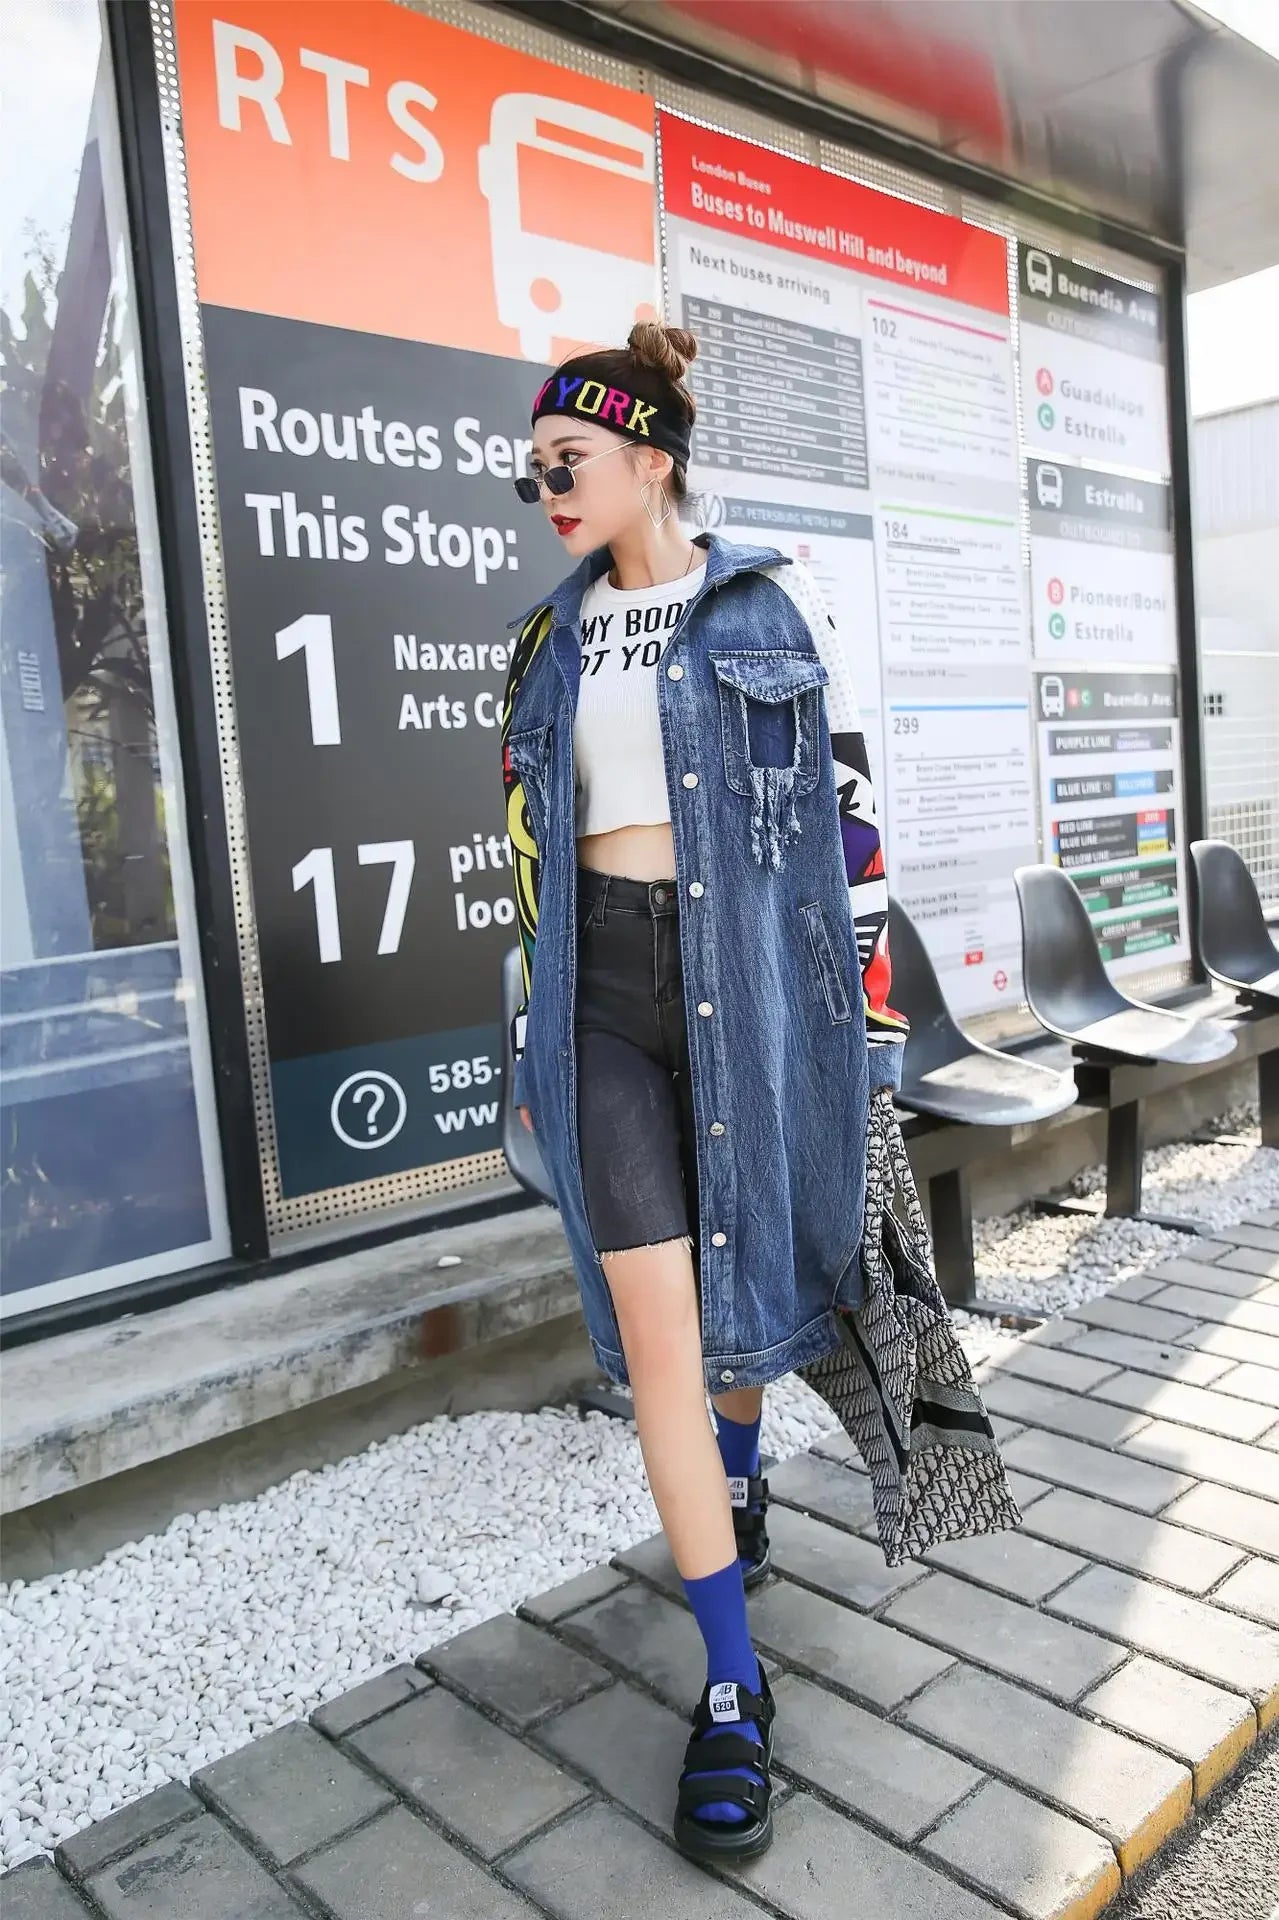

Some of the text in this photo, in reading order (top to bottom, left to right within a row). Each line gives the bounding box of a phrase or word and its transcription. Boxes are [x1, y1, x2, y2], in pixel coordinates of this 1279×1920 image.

[212, 18, 444, 183] RTS
[692, 155, 735, 183] London
[691, 181, 947, 286] Buses to Muswell Hill and beyond
[690, 246, 831, 305] Next buses arriving
[873, 317, 897, 339] 102
[556, 376, 658, 437] YORK
[1060, 380, 1144, 417] Guadalupe
[238, 386, 533, 480] Routes Ser
[1064, 416, 1126, 446] Estrella
[1085, 485, 1144, 514] Estrella
[244, 491, 519, 585] This Stop:
[884, 520, 908, 540] 184
[581, 599, 692, 647] MY BOD
[1075, 622, 1134, 643] Estrella
[274, 613, 342, 746] 1
[398, 693, 467, 730] Arts
[893, 717, 919, 735] 299
[1056, 736, 1090, 750] PURPLE
[1091, 735, 1112, 748] LINE
[1057, 782, 1080, 796] BLUE
[1081, 780, 1101, 794] LINE
[1059, 820, 1093, 833] RED LINE
[1060, 834, 1098, 849] BLUE LINE
[1061, 850, 1110, 867] YELLOW LINE
[291, 832, 513, 964] 17 pitt
[455, 892, 516, 931] loo
